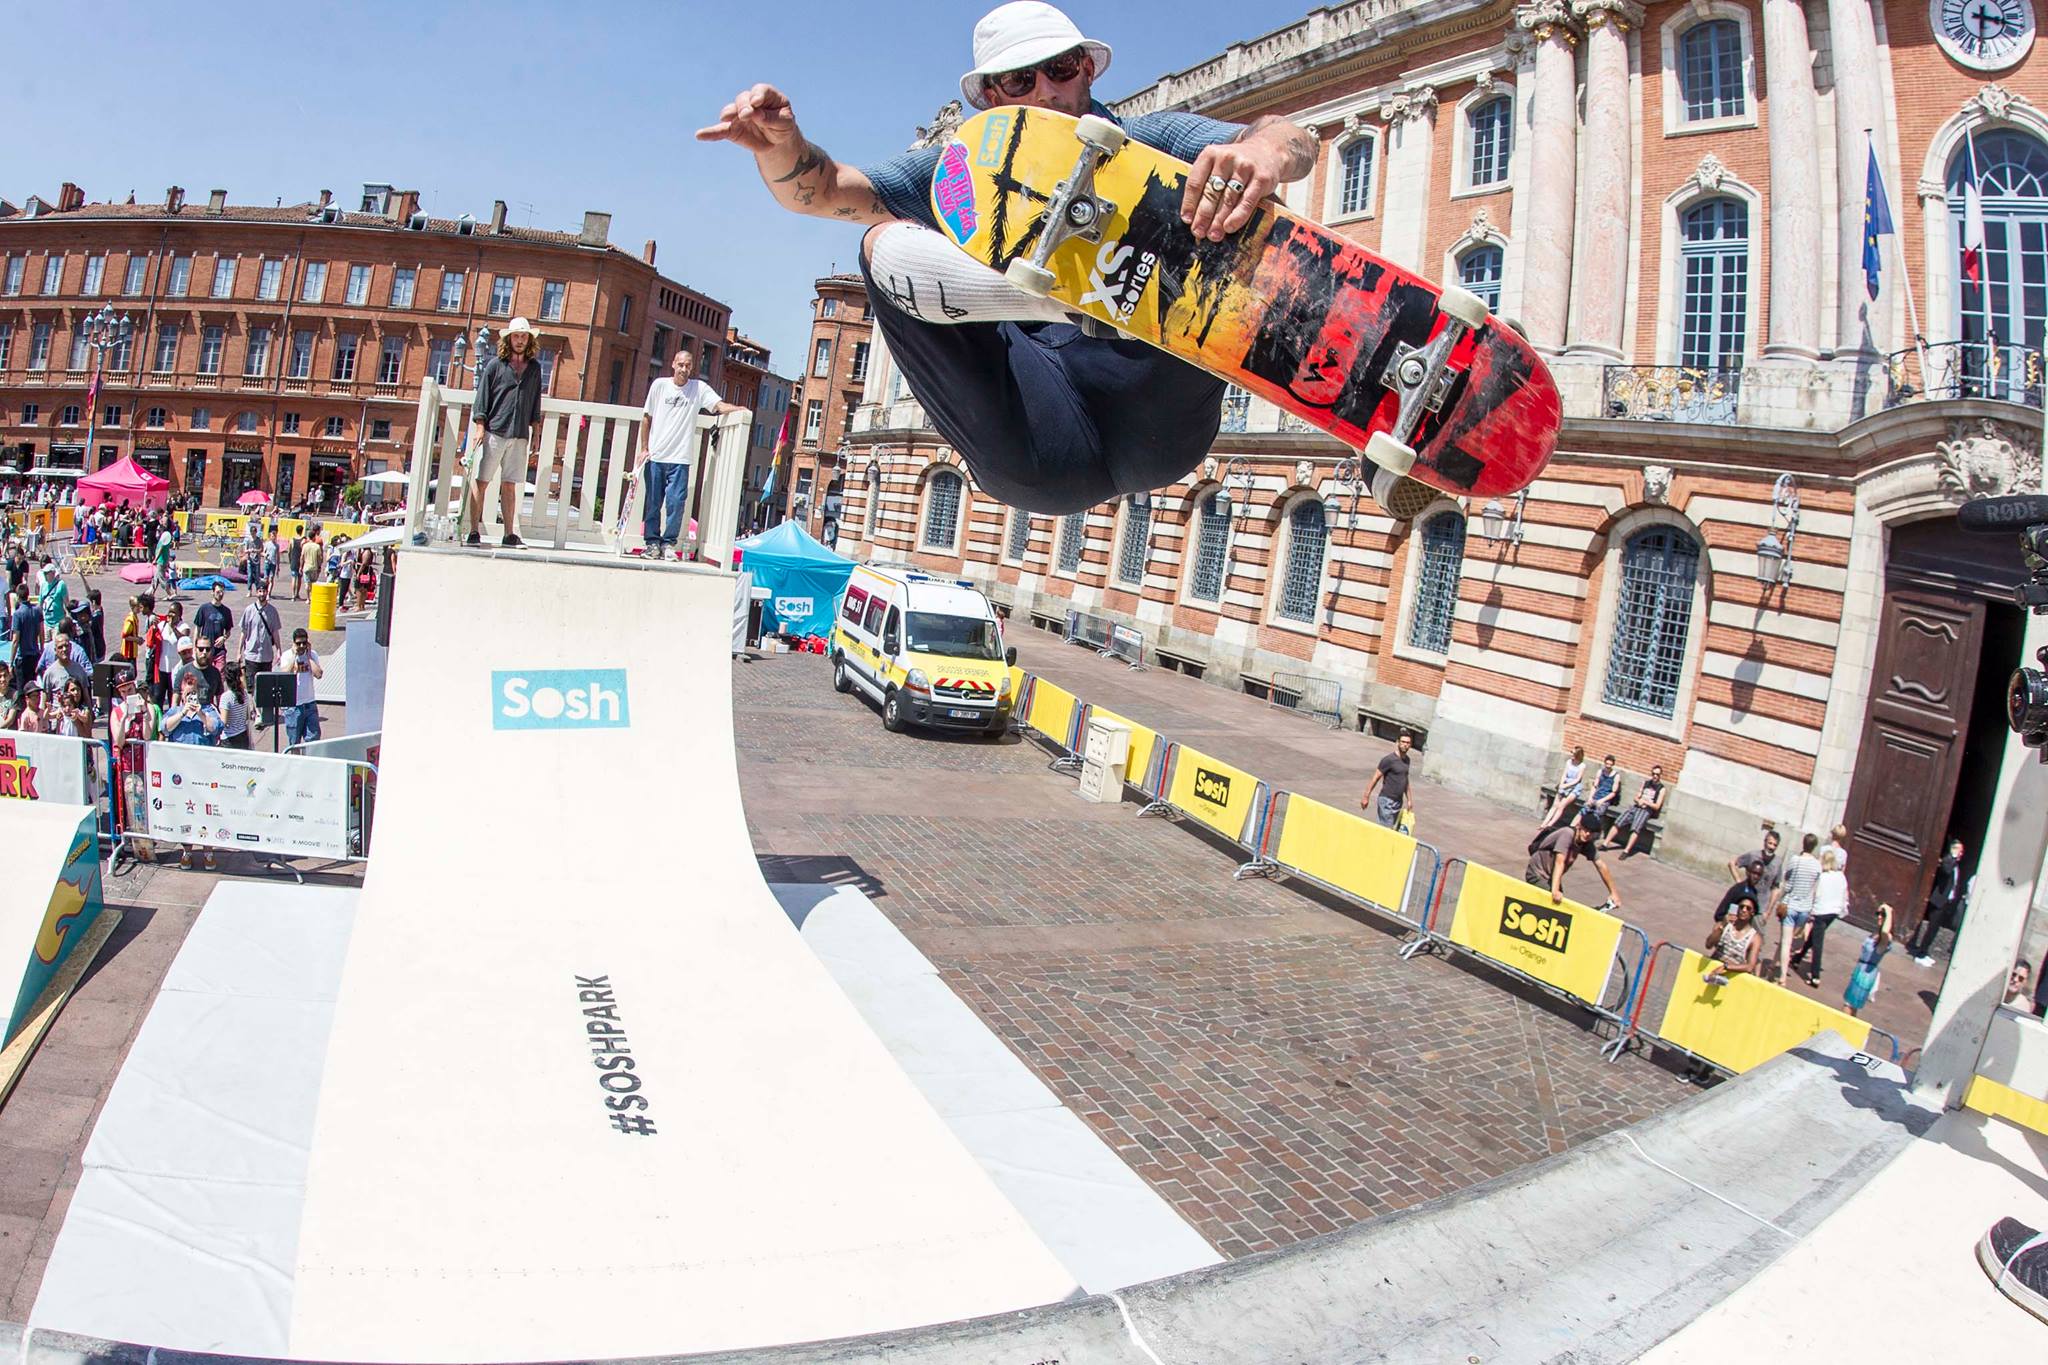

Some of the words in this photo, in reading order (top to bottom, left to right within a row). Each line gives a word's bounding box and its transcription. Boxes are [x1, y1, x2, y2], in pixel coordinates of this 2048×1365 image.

[1116, 251, 1156, 326] xsories
[779, 599, 811, 613] Sosh
[502, 677, 621, 721] Sosh
[1196, 771, 1228, 804] Sosh
[1503, 902, 1568, 949] Sosh
[574, 975, 658, 1136] #SOSHPARK
